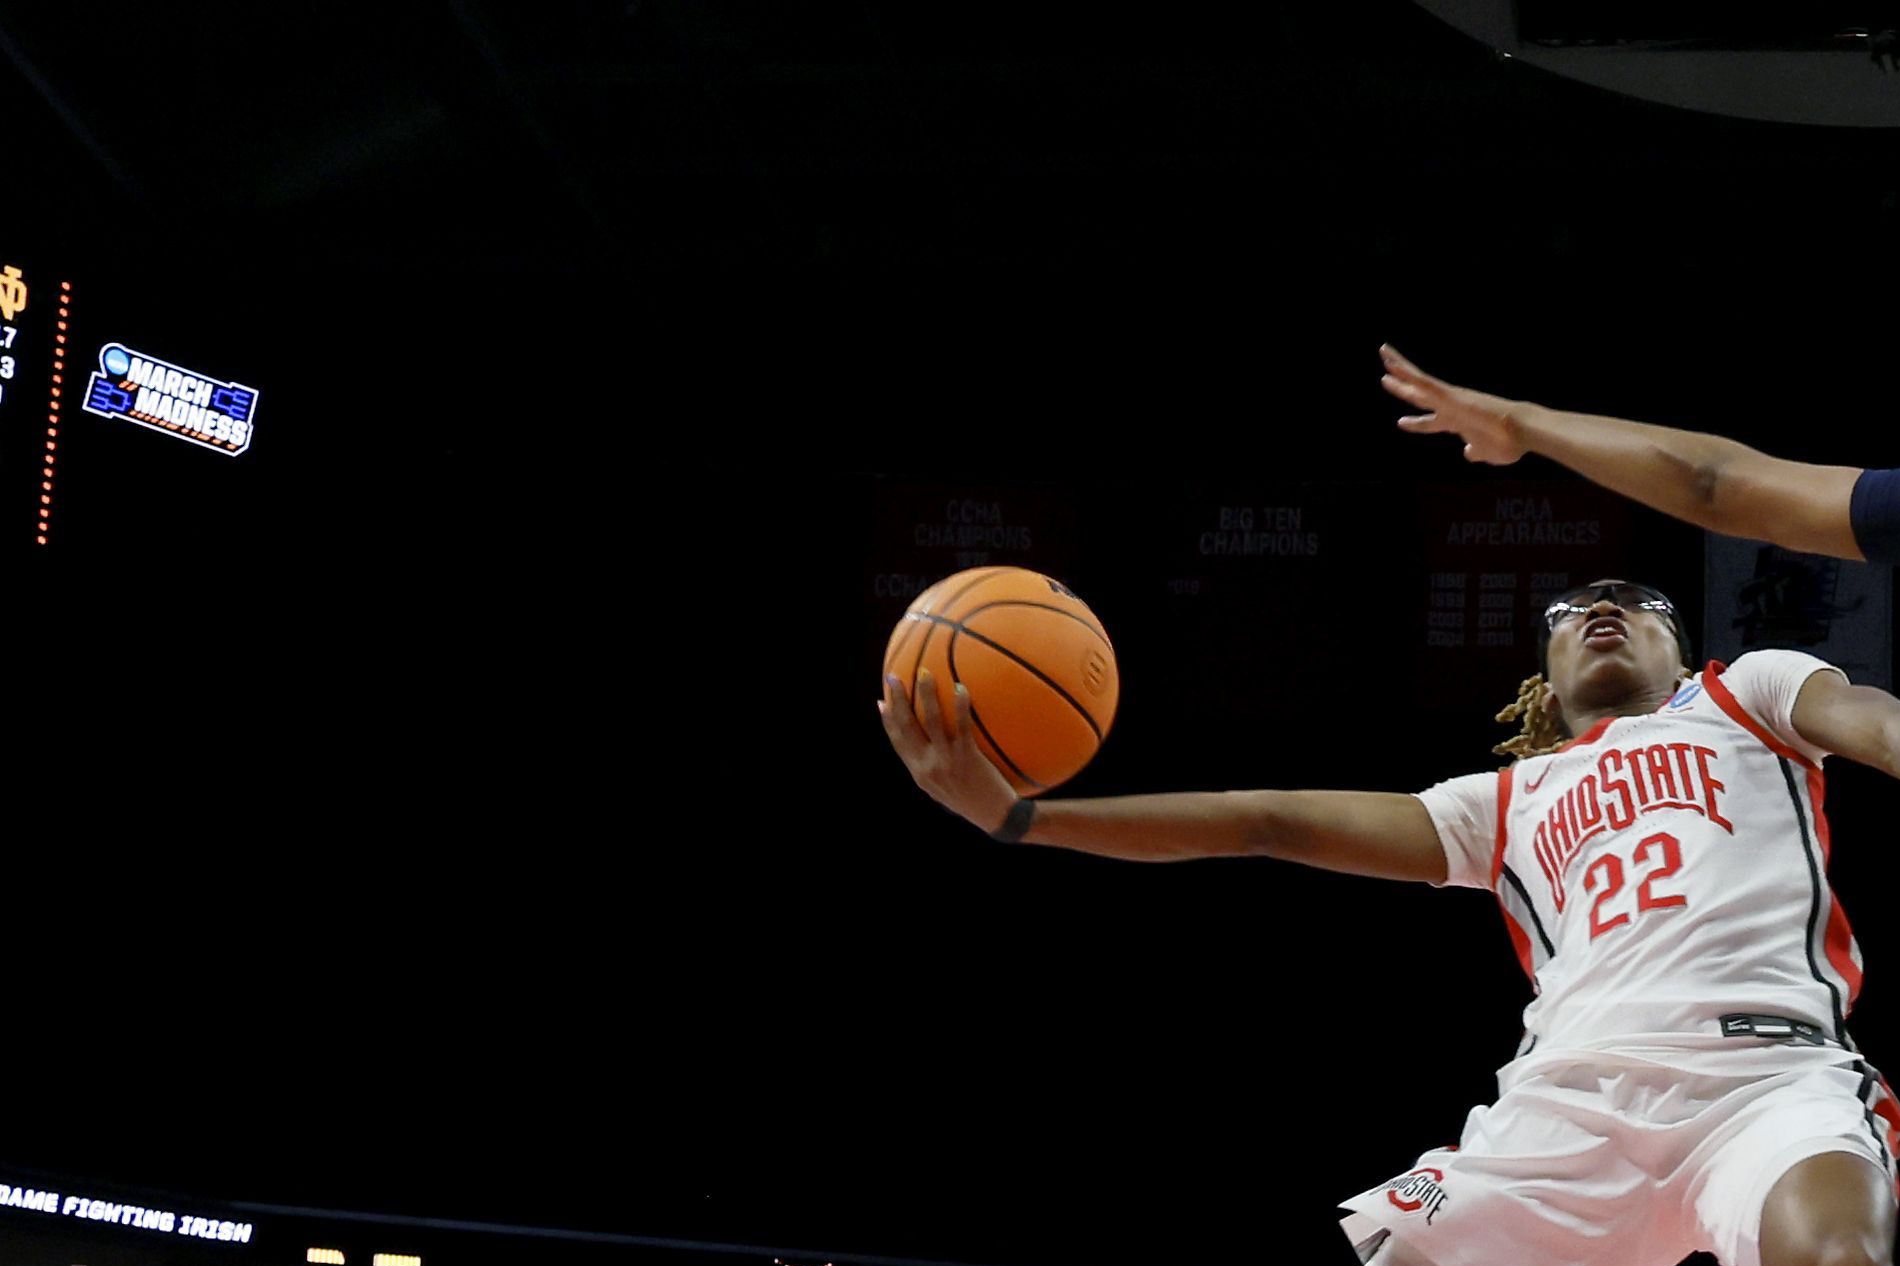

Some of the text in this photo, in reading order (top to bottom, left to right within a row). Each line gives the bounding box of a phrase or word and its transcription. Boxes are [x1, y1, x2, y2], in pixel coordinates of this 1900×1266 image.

[127, 357, 214, 407] MARCH
[133, 387, 250, 445] MADNESS
[1199, 531, 1320, 556] CHAMPIONS
[1445, 520, 1601, 545] APPEARANCES
[1582, 832, 1688, 944] 22
[62, 1196, 175, 1232] FIGHTING
[178, 1215, 252, 1243] IRISH
